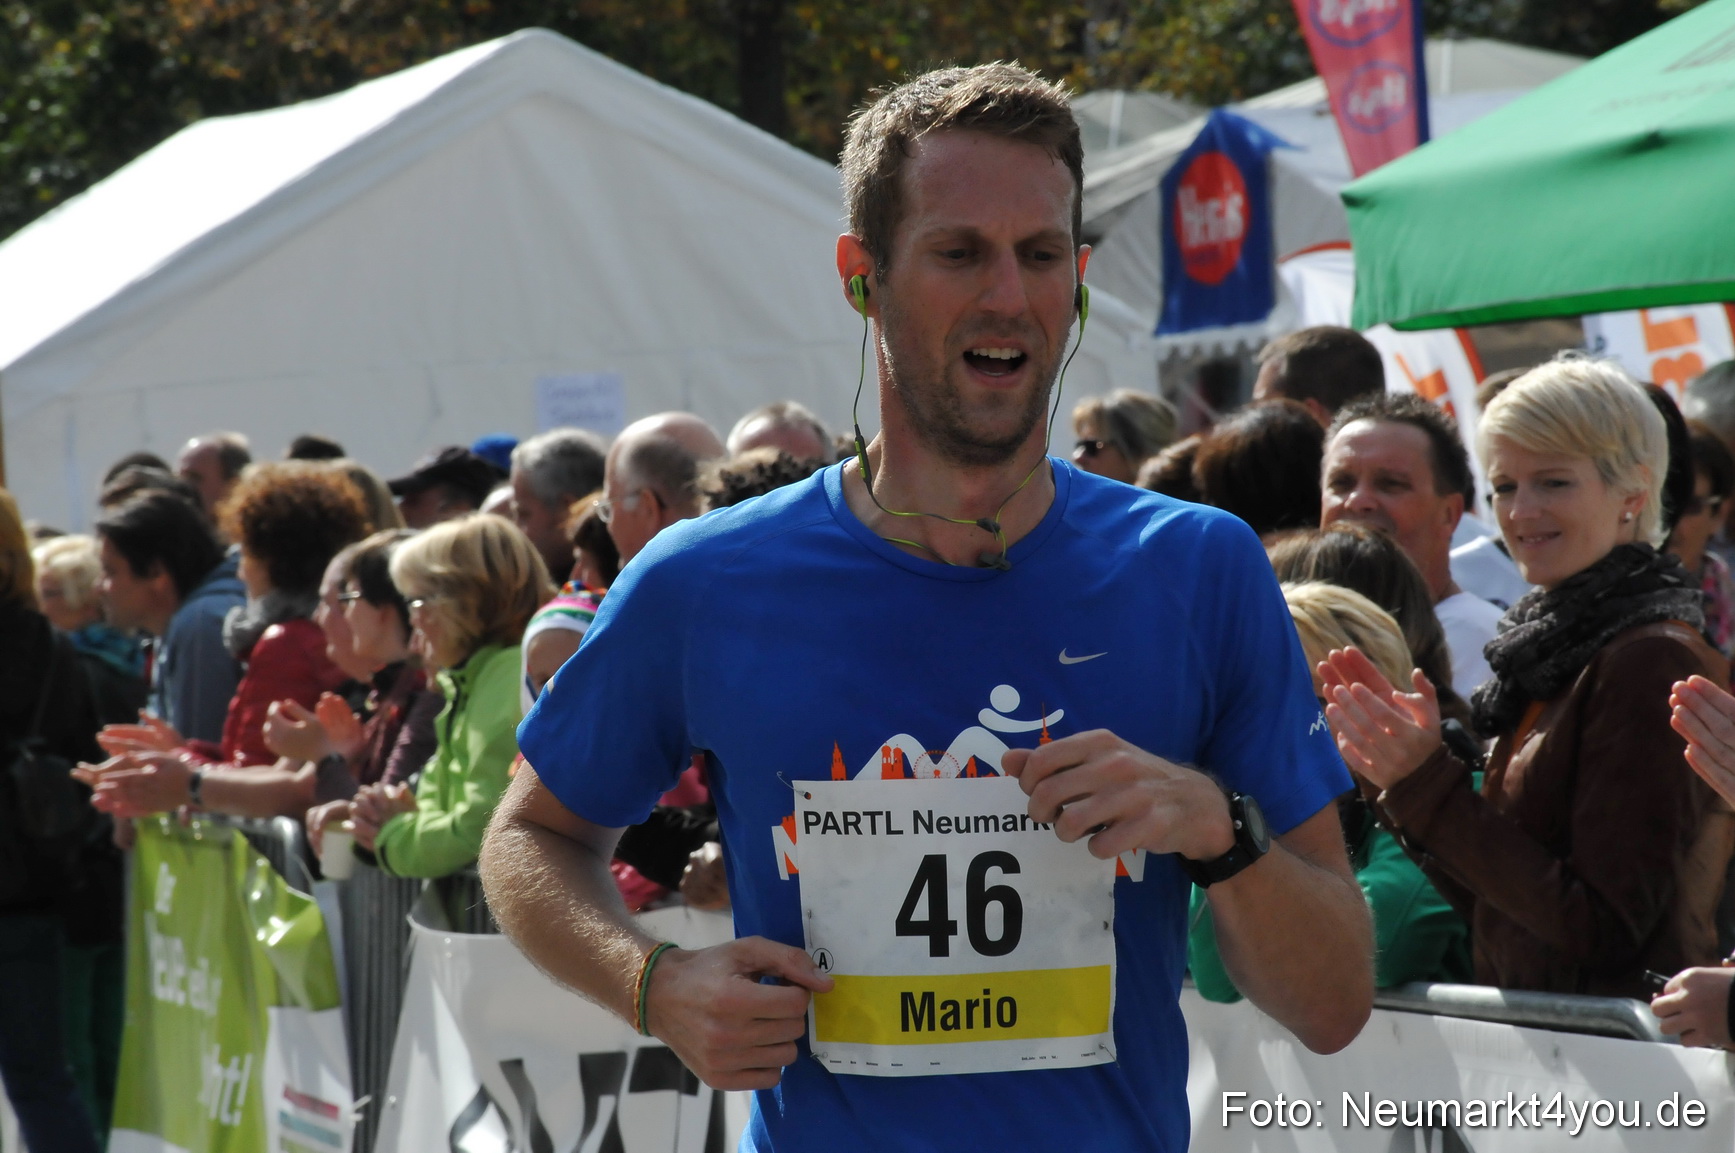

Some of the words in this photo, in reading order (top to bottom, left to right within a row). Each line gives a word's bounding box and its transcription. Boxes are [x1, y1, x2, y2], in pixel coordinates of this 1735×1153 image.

[803, 811, 904, 836] PARTL
[912, 809, 1056, 835] Neumar
[895, 850, 1024, 958] 46
[900, 988, 1018, 1032] Mario
